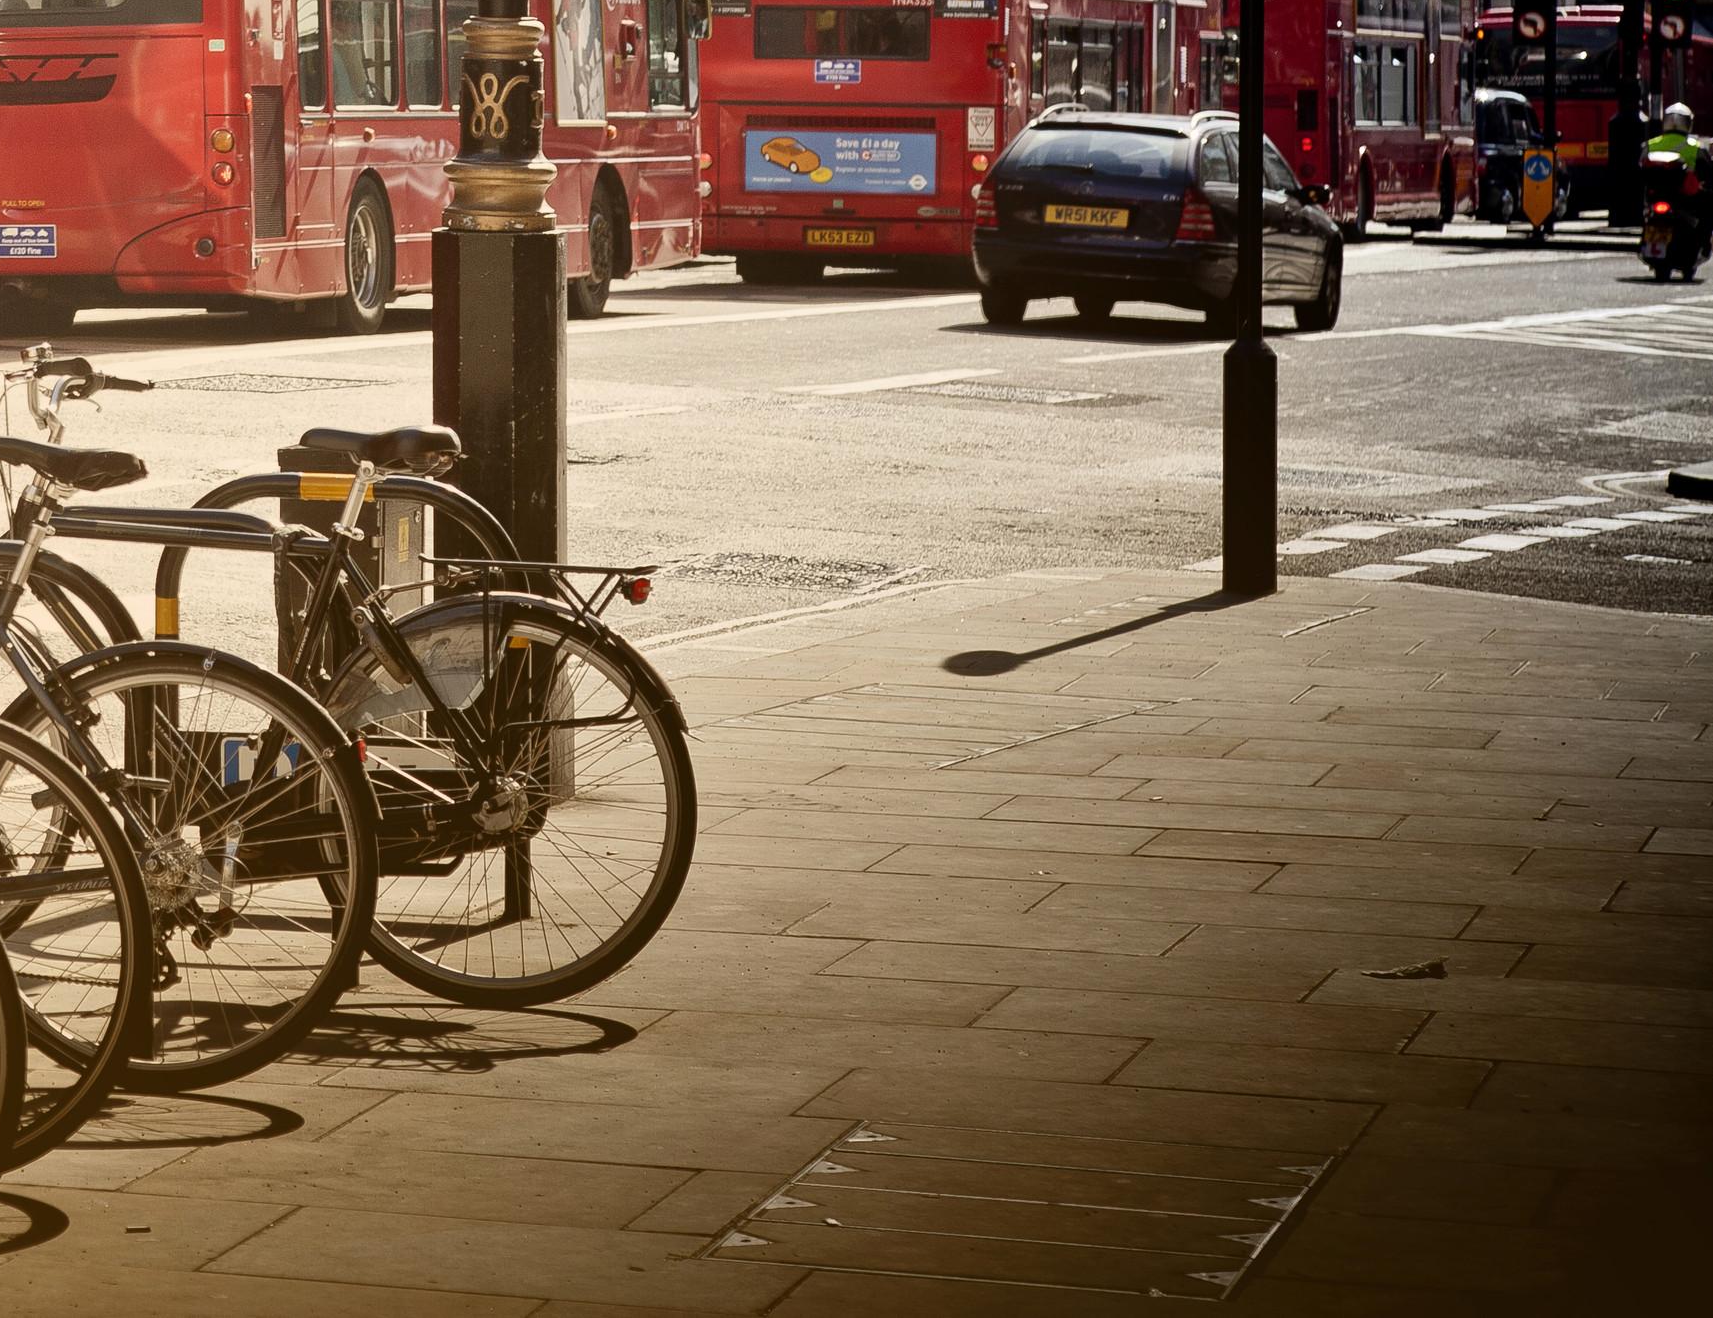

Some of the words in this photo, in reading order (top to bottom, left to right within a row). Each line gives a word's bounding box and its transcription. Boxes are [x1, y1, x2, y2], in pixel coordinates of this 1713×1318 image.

[947, 0, 972, 9] BATMAN
[972, 0, 985, 9] LIVE
[836, 138, 858, 149] Save
[874, 140, 880, 148] a
[881, 138, 900, 150] day
[836, 151, 859, 161] with
[1055, 205, 1087, 220] WR51
[1091, 208, 1118, 222] KKF
[812, 232, 843, 244] LK53
[10, 247, 26, 255] £120
[27, 247, 42, 255] fine
